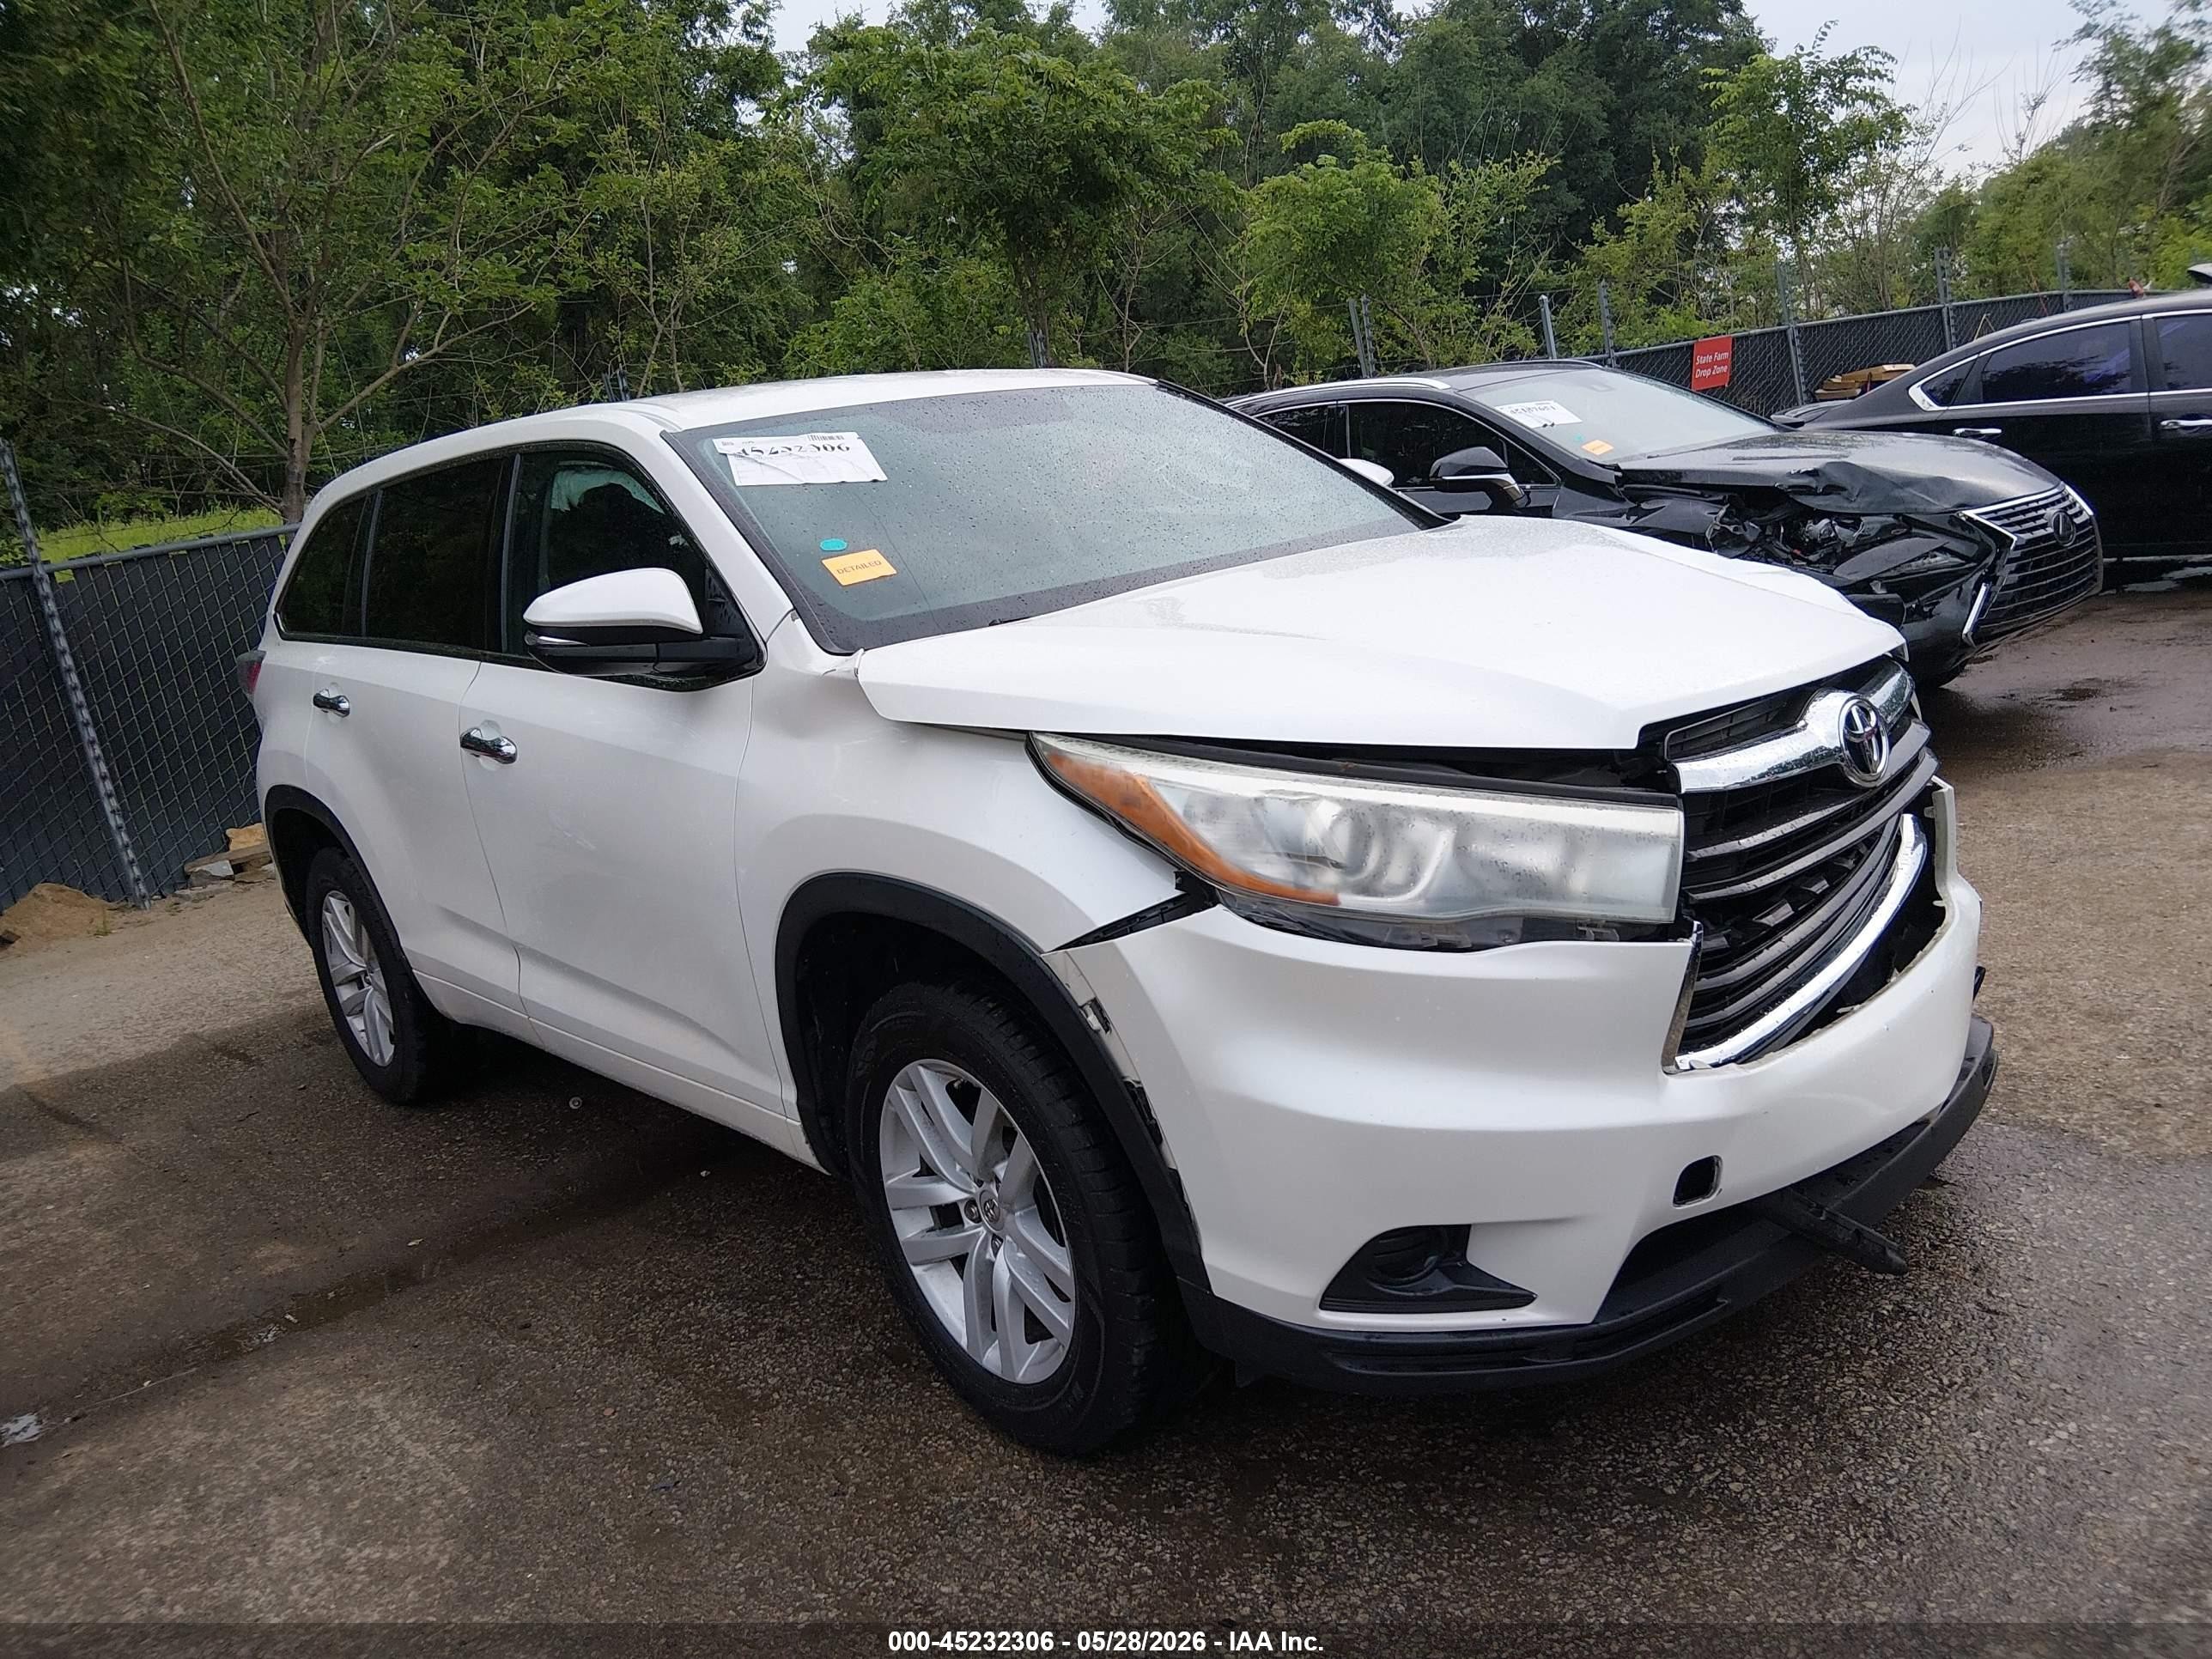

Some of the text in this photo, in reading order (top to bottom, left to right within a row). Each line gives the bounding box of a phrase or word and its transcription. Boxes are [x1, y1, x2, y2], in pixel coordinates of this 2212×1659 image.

[1696, 351, 1729, 365] State Farm
[1695, 364, 1729, 379] Drop Zone
[836, 560, 882, 574] DETAILED
